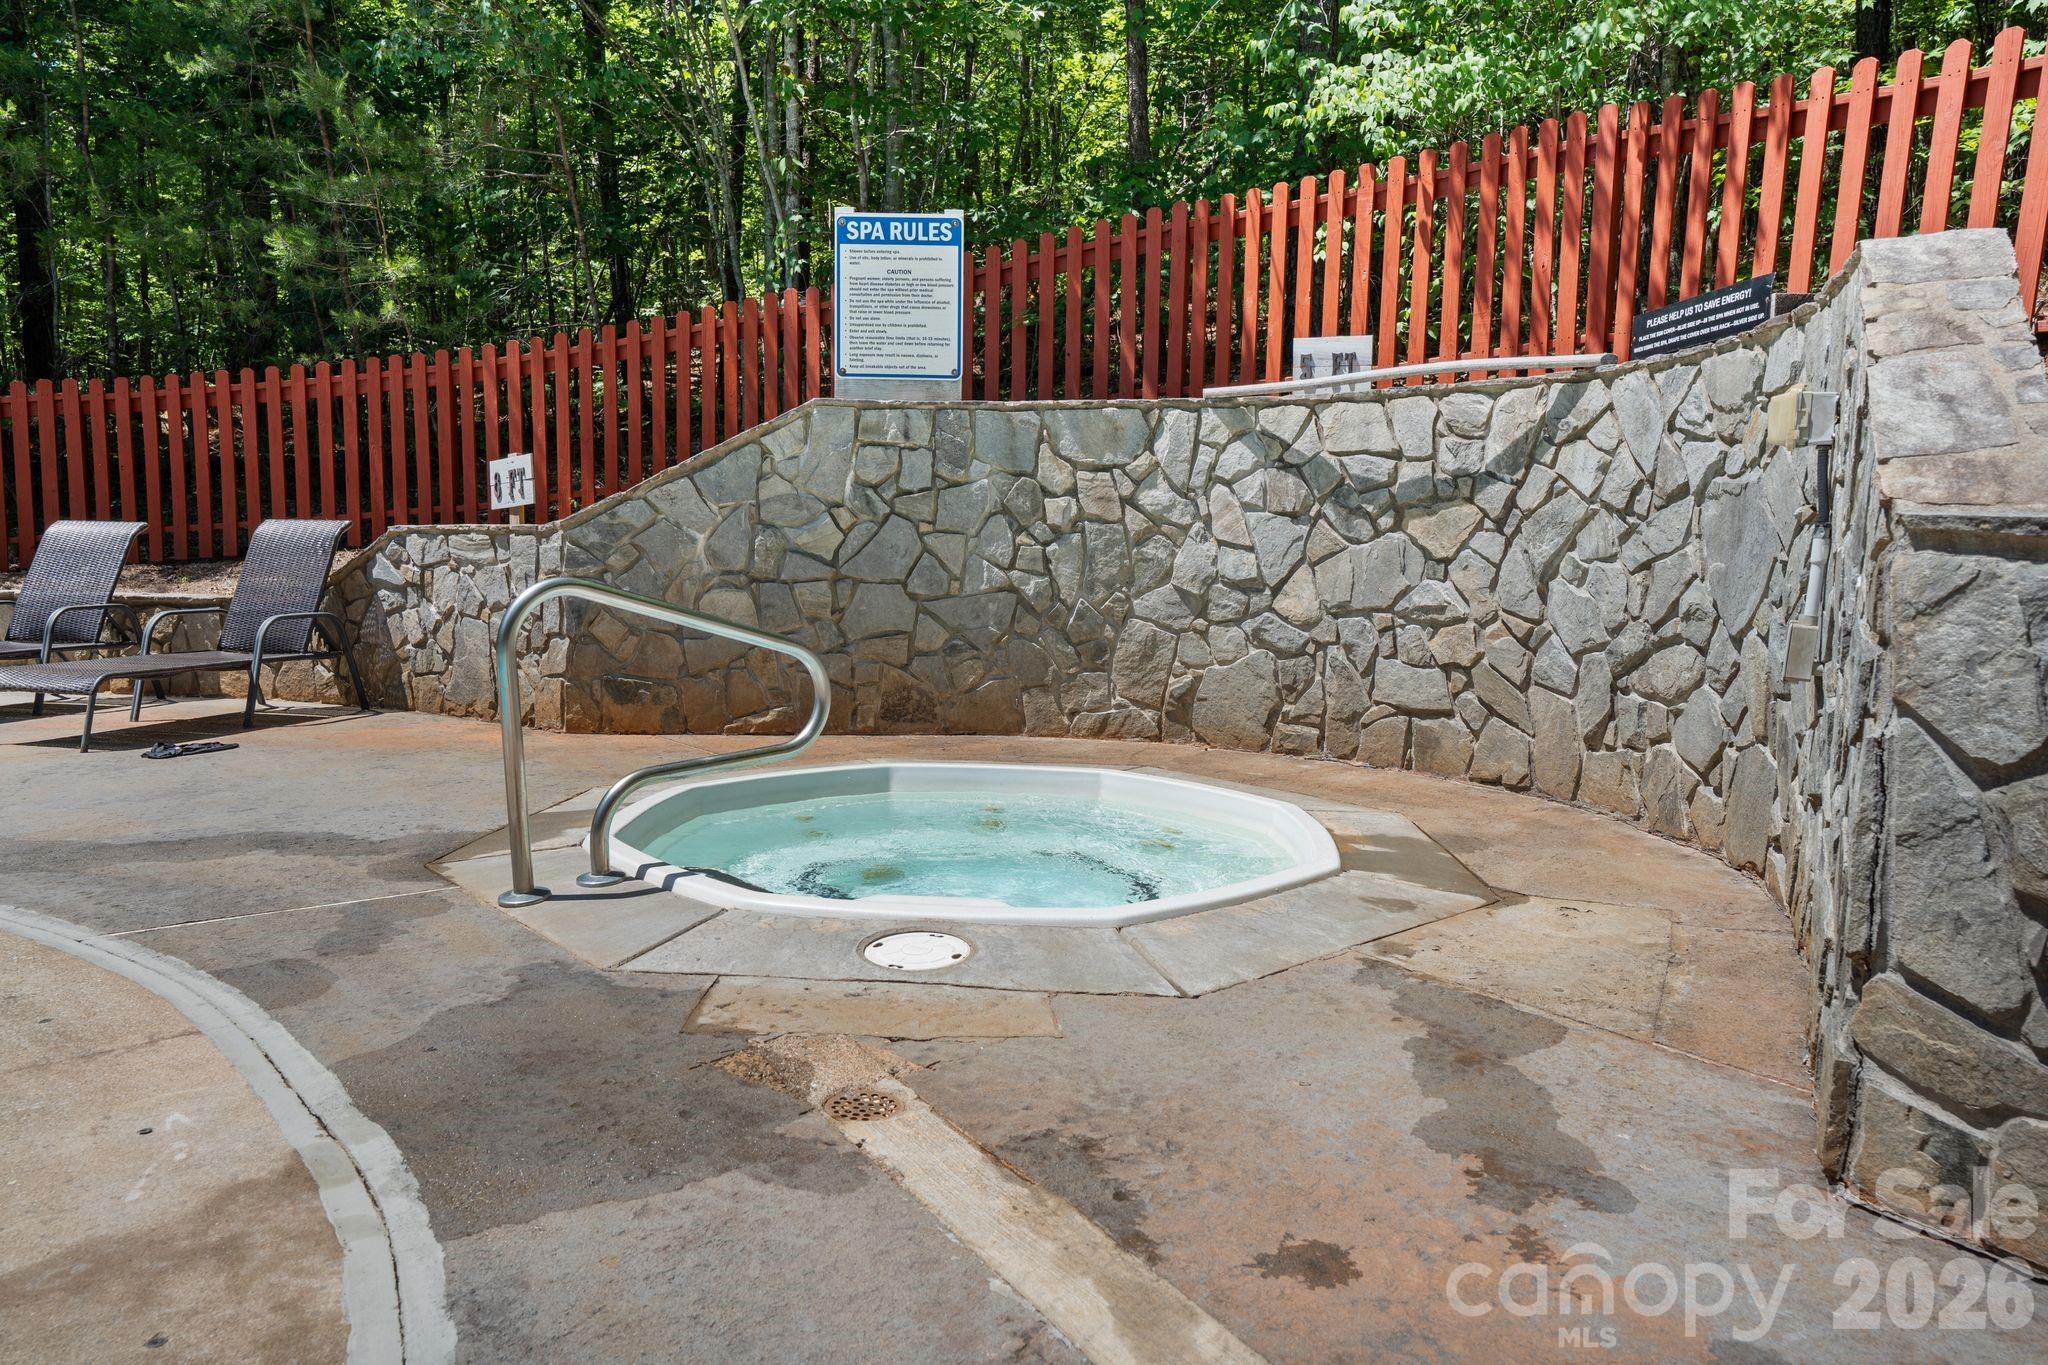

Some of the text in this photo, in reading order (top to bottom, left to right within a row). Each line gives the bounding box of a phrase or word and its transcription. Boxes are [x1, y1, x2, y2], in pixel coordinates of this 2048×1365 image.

[846, 221, 952, 241] SPA RULES
[1647, 288, 1752, 328] PLEASE HELP US TO SAVE ENERGY!
[508, 467, 526, 500] FT
